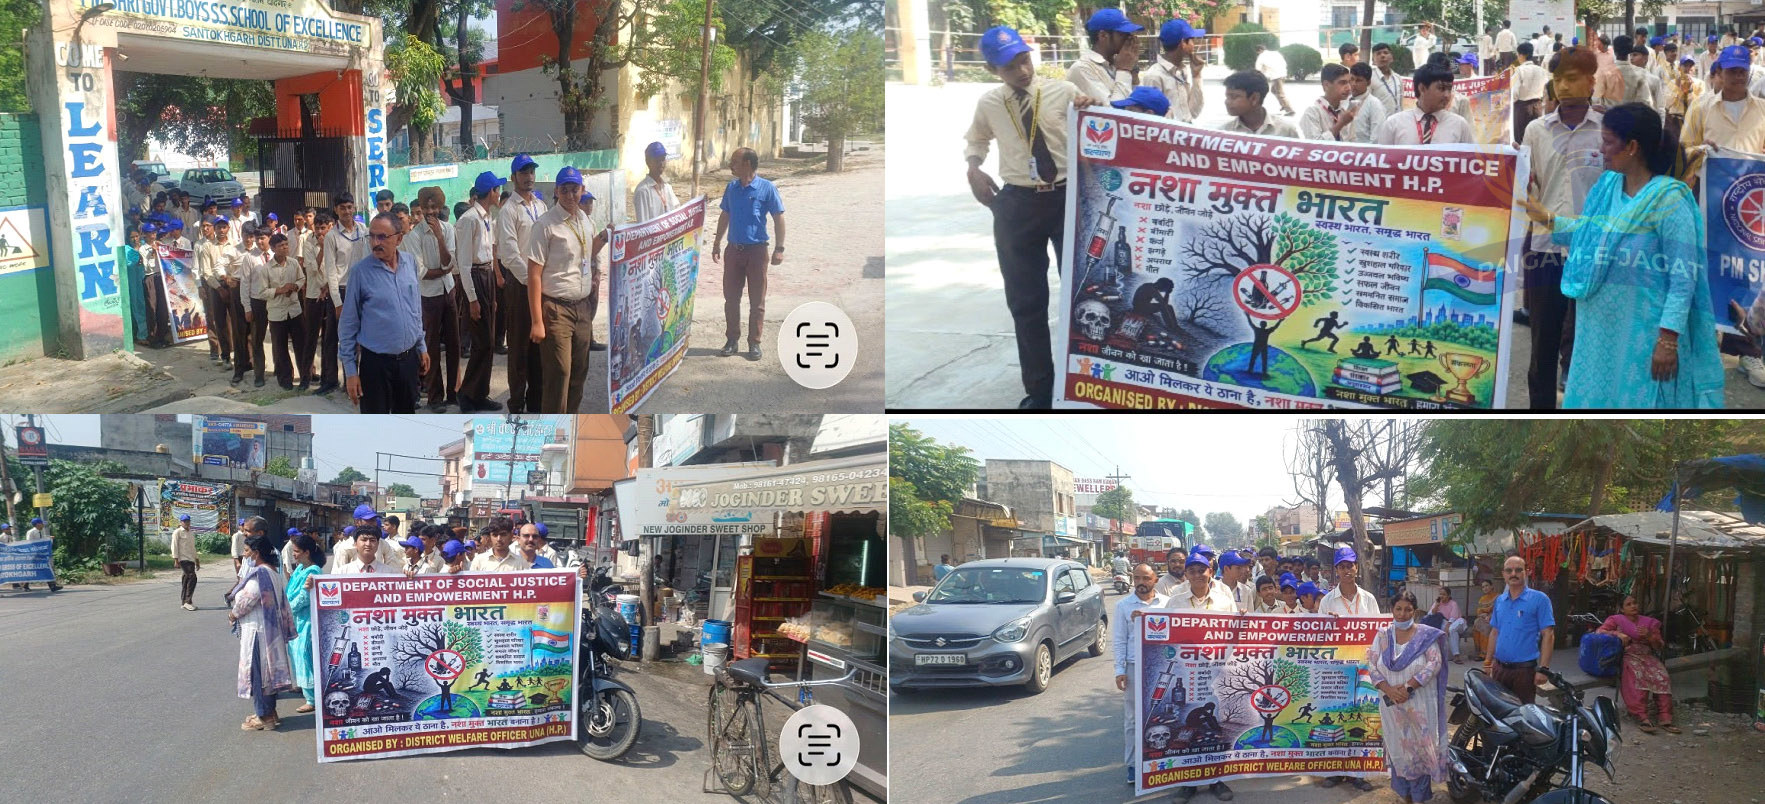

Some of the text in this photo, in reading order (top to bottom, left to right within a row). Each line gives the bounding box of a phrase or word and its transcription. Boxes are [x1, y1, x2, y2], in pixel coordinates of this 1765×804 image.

[182, 26, 255, 45] SANTOKHGARH
[275, 13, 290, 32] OF
[294, 16, 361, 42] EXCELLENCE
[55, 42, 104, 68] COME
[70, 72, 94, 92] TO
[370, 89, 379, 102] TO
[1119, 122, 1500, 177] DEPARTMENT OF SOCIAL JUSTICE
[1165, 149, 1444, 194] AND EMPOWERMENT H.P.
[65, 101, 118, 300] LEARN
[1128, 171, 1390, 226] नशा मुक्त भारत
[1134, 202, 1152, 211] नशा
[1315, 220, 1342, 231] स्वस्थ
[1406, 230, 1432, 241] भारत
[1720, 253, 1744, 280] PM
[1101, 345, 1123, 359] जीवन
[1125, 349, 1136, 361] को
[1153, 356, 1175, 369] जाता
[1075, 381, 1153, 408] ORGANISED
[1125, 367, 1154, 385] आओ
[1159, 371, 1201, 394] मिलकर
[1204, 382, 1213, 397] ये
[1217, 386, 1243, 402] ठाना
[1336, 390, 1356, 400] नशा
[711, 487, 804, 509] JOGINDER
[643, 525, 766, 534] NEW JOGINDER SWEET SHOP
[343, 576, 567, 592] DEPARTMENT OF SOCIAL JUSTICE
[374, 589, 537, 604] AND EMPOWERMENT H.P.
[352, 605, 507, 627] नशा मुक्त भारत
[1171, 617, 1268, 630] DEPARTMENT
[1271, 620, 1289, 630] OF
[1293, 620, 1340, 631] SOCIAL
[1204, 630, 1367, 642] AND EMPOWERMENT H.P.
[1180, 646, 1338, 662] नशा मुक्त भारत
[362, 724, 383, 735] आओ
[385, 723, 413, 733] मिलकर
[423, 721, 438, 730] ठाना
[451, 721, 466, 729] नशा
[468, 719, 485, 729] मुक्त
[487, 718, 508, 727] भारत
[329, 740, 383, 755] ORGANISED
[385, 738, 398, 749] BY
[405, 734, 447, 747] DISTRICT
[448, 732, 488, 744] WELFARE
[490, 731, 527, 742] OFFICER
[529, 730, 544, 739] UNA
[546, 724, 567, 737] (H.P.)
[1182, 754, 1202, 764] आओ
[1205, 753, 1232, 763] मिलकर
[1270, 749, 1286, 757] नशा
[1288, 748, 1304, 758] मुक्त
[1305, 749, 1326, 758] भारत
[1148, 769, 1202, 786] ORGANISED
[1204, 767, 1217, 777] BY
[1223, 762, 1263, 773] DISTRICT
[1266, 760, 1305, 770] WELFARE
[1307, 760, 1343, 770] OFFICER
[1344, 759, 1361, 769] UNA
[1363, 759, 1384, 770] (H.P.)
